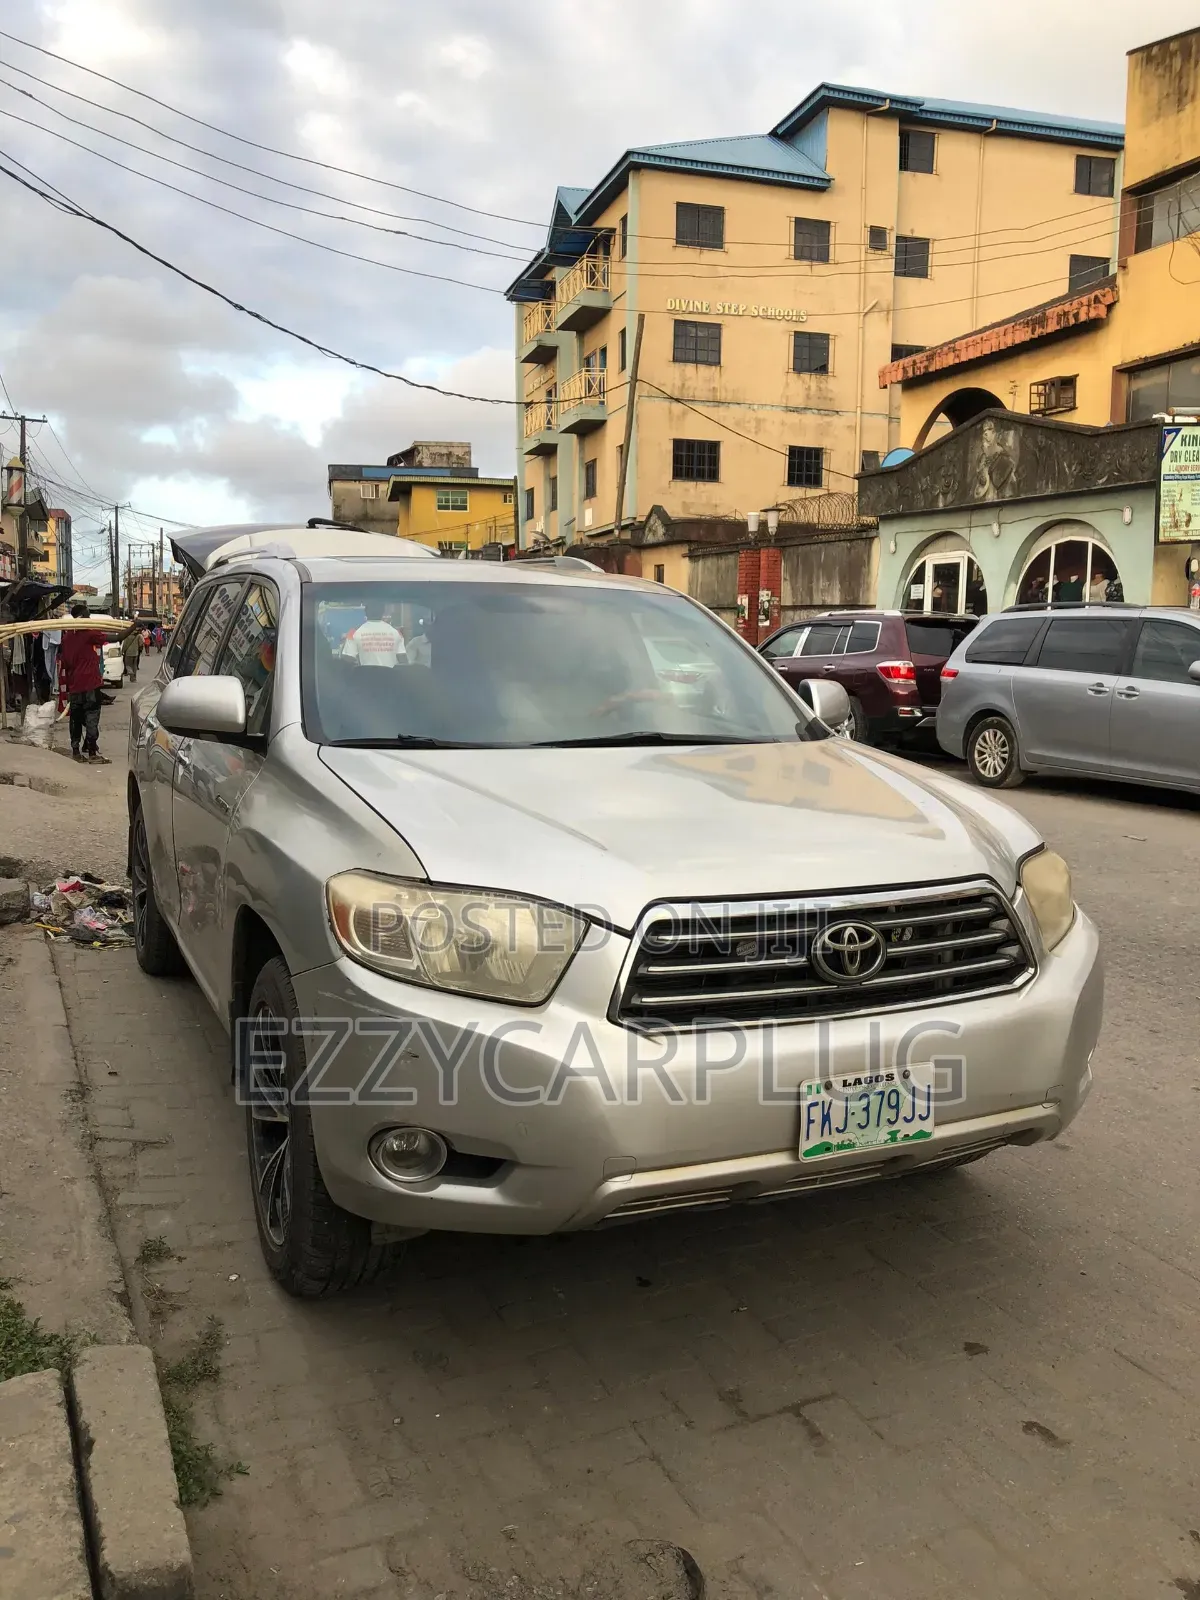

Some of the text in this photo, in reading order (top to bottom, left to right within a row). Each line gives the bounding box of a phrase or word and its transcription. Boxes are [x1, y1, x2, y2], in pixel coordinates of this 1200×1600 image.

[666, 298, 808, 322] DIVINE STEP SCHOOLS
[1181, 434, 1200, 447] KIN
[1170, 450, 1200, 462] DRY CLEA
[842, 1073, 895, 1088] LAGOS
